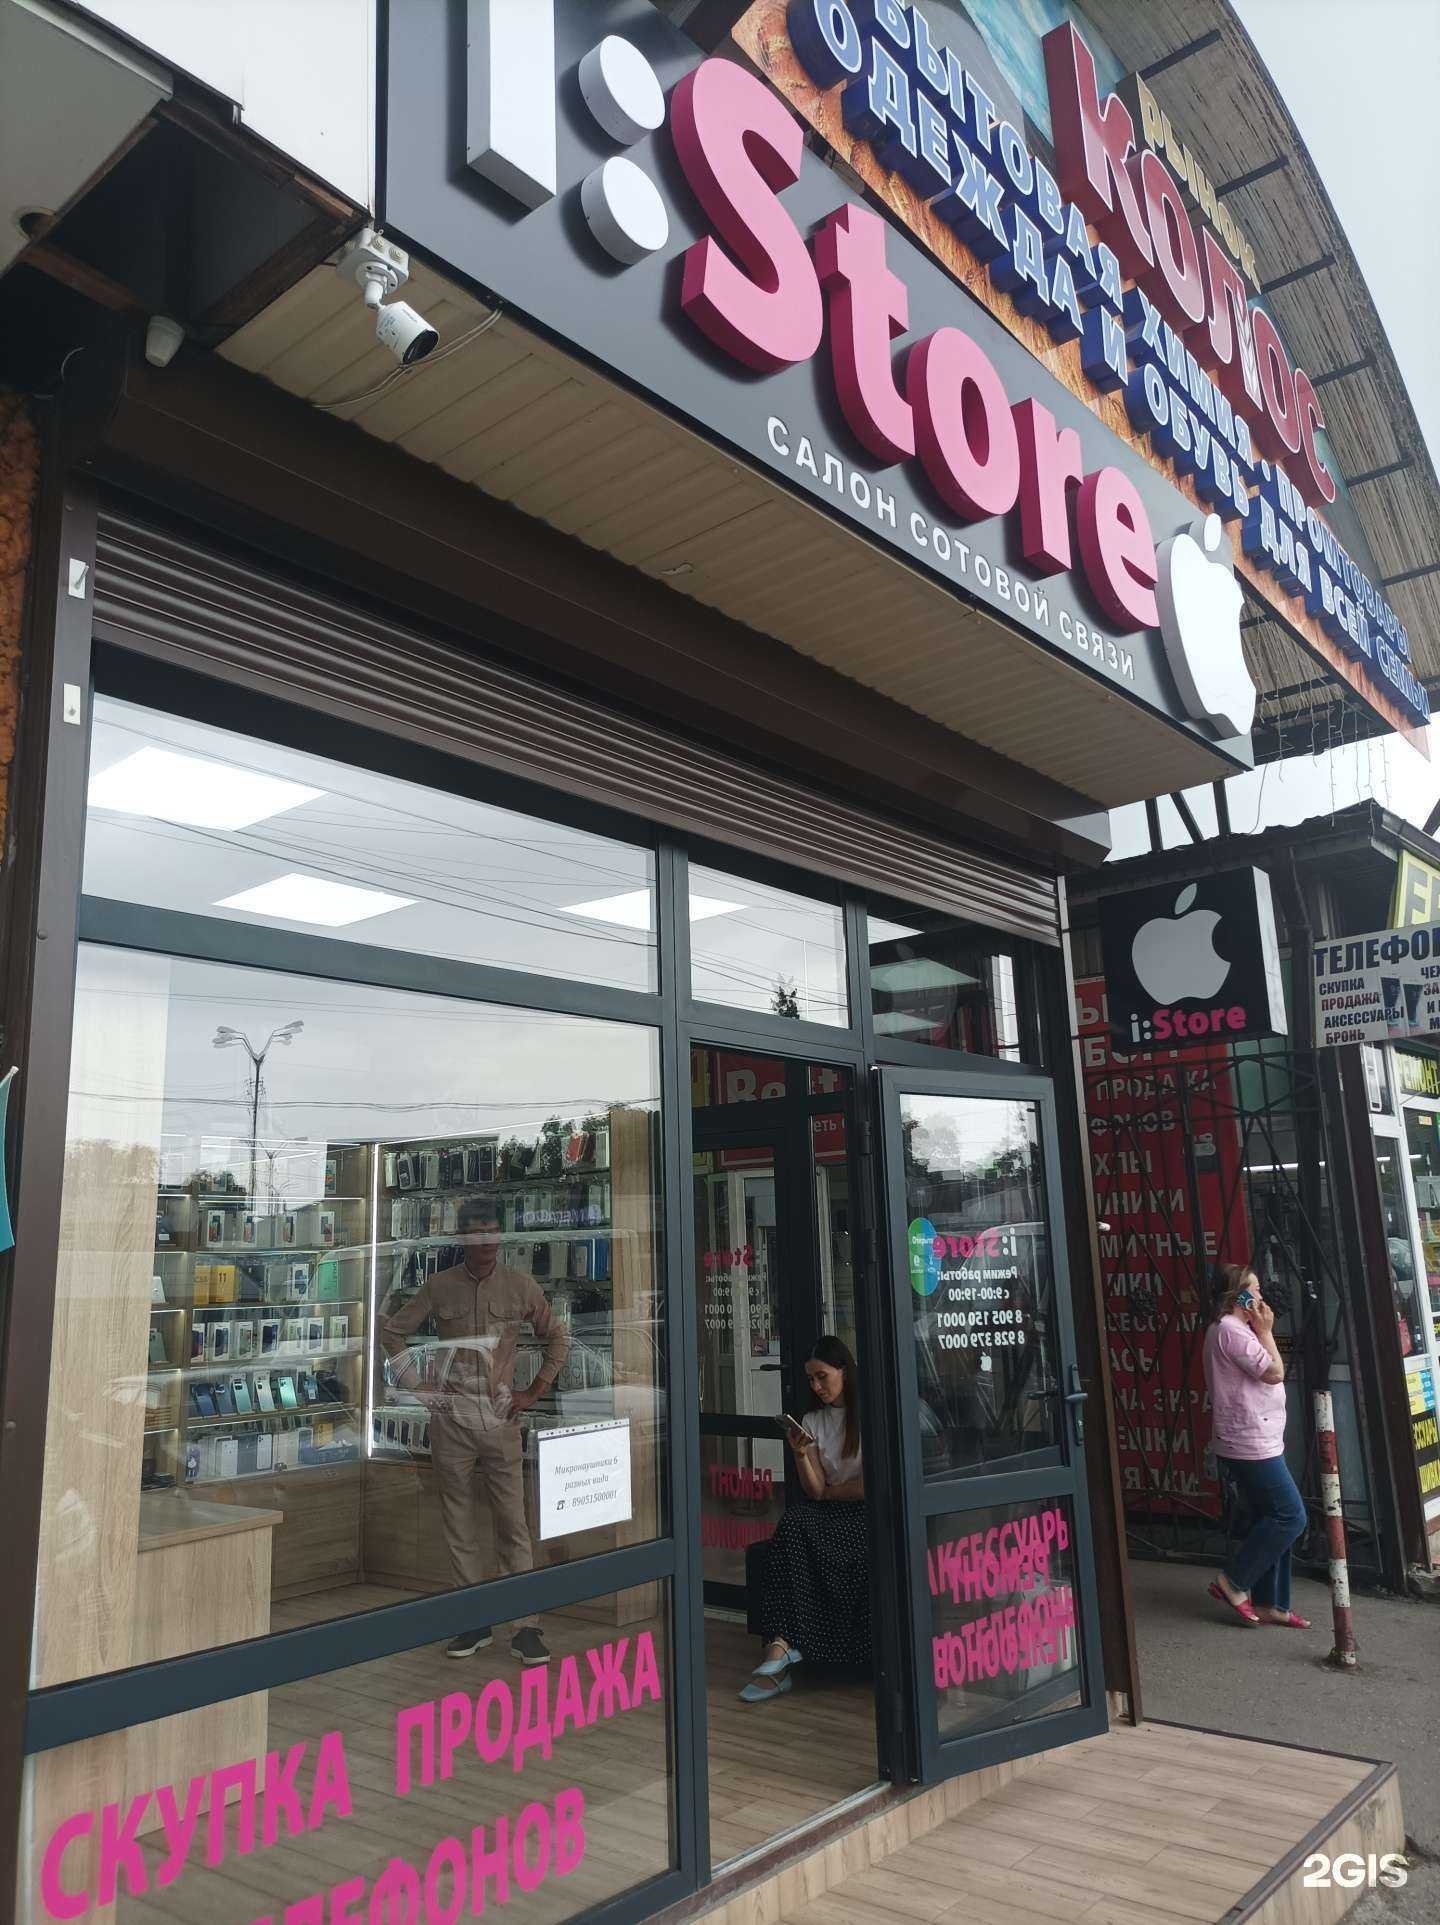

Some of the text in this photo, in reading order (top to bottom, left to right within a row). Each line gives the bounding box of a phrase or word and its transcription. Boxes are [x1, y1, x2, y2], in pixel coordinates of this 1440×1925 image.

[1066, 20, 1336, 503] КОЛОС
[1135, 71, 1262, 295] РЫНОК
[813, 0, 1085, 335] ОДЕЖДА
[1101, 304, 1129, 387] И
[1144, 362, 1250, 518] ОБУВЬ
[1259, 494, 1312, 593] ДЛЯ
[1318, 565, 1373, 659] ВСЕЙ
[766, 416, 1136, 681] САЛОН СОТОВОЙ СВЯЗИ
[1137, 286, 1254, 471] ХИМИЯ
[1275, 463, 1413, 665] ПРОМТОВАРЫ
[1130, 1005, 1248, 1044] i:Store
[1318, 977, 1366, 996] СКУПКА
[1320, 991, 1381, 1012] ПРОДАЖА
[1323, 1006, 1405, 1029] АКСЕССУАРЫ
[40, 1631, 662, 1920] СКУПКА ПРОДАЖА
